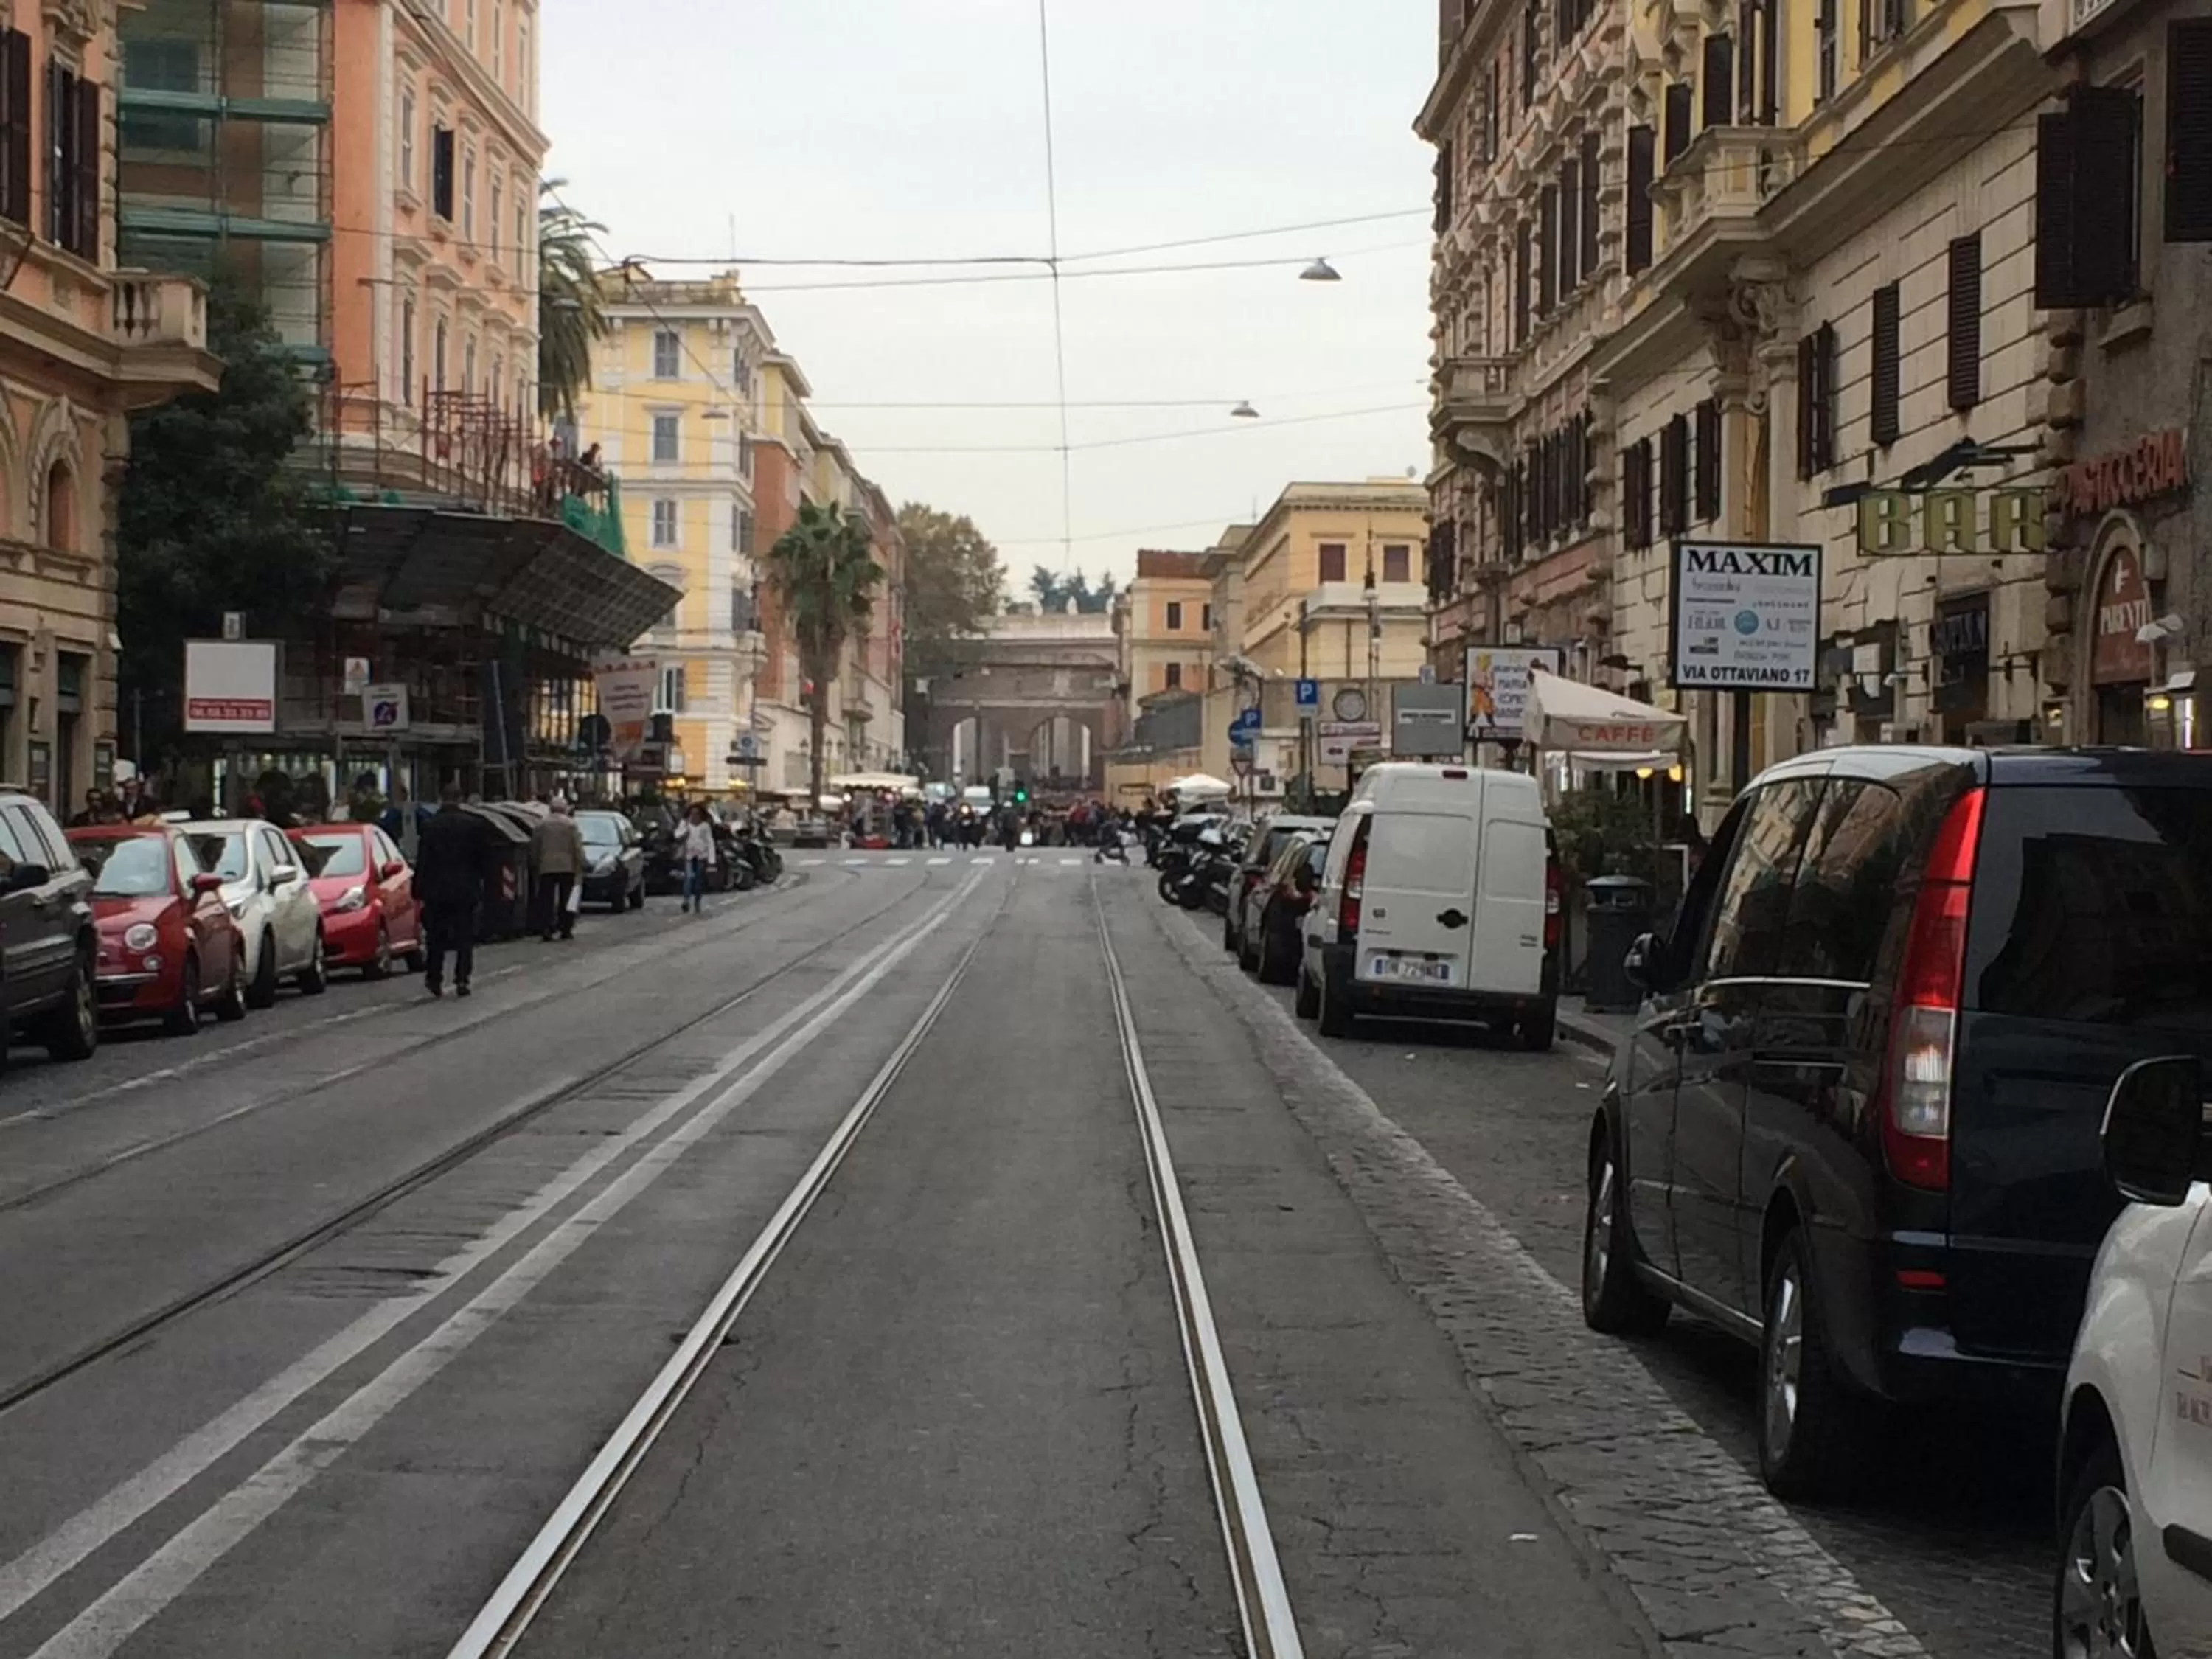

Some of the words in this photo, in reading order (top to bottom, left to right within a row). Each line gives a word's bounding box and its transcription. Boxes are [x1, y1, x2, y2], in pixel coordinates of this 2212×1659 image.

[1859, 491, 2045, 554] BAR
[1688, 550, 1812, 576] MAXIM
[1683, 664, 1706, 681] VIA
[1711, 665, 1790, 683] OTTAVIANO
[1794, 669, 1809, 683] 17
[1300, 683, 1313, 701] P
